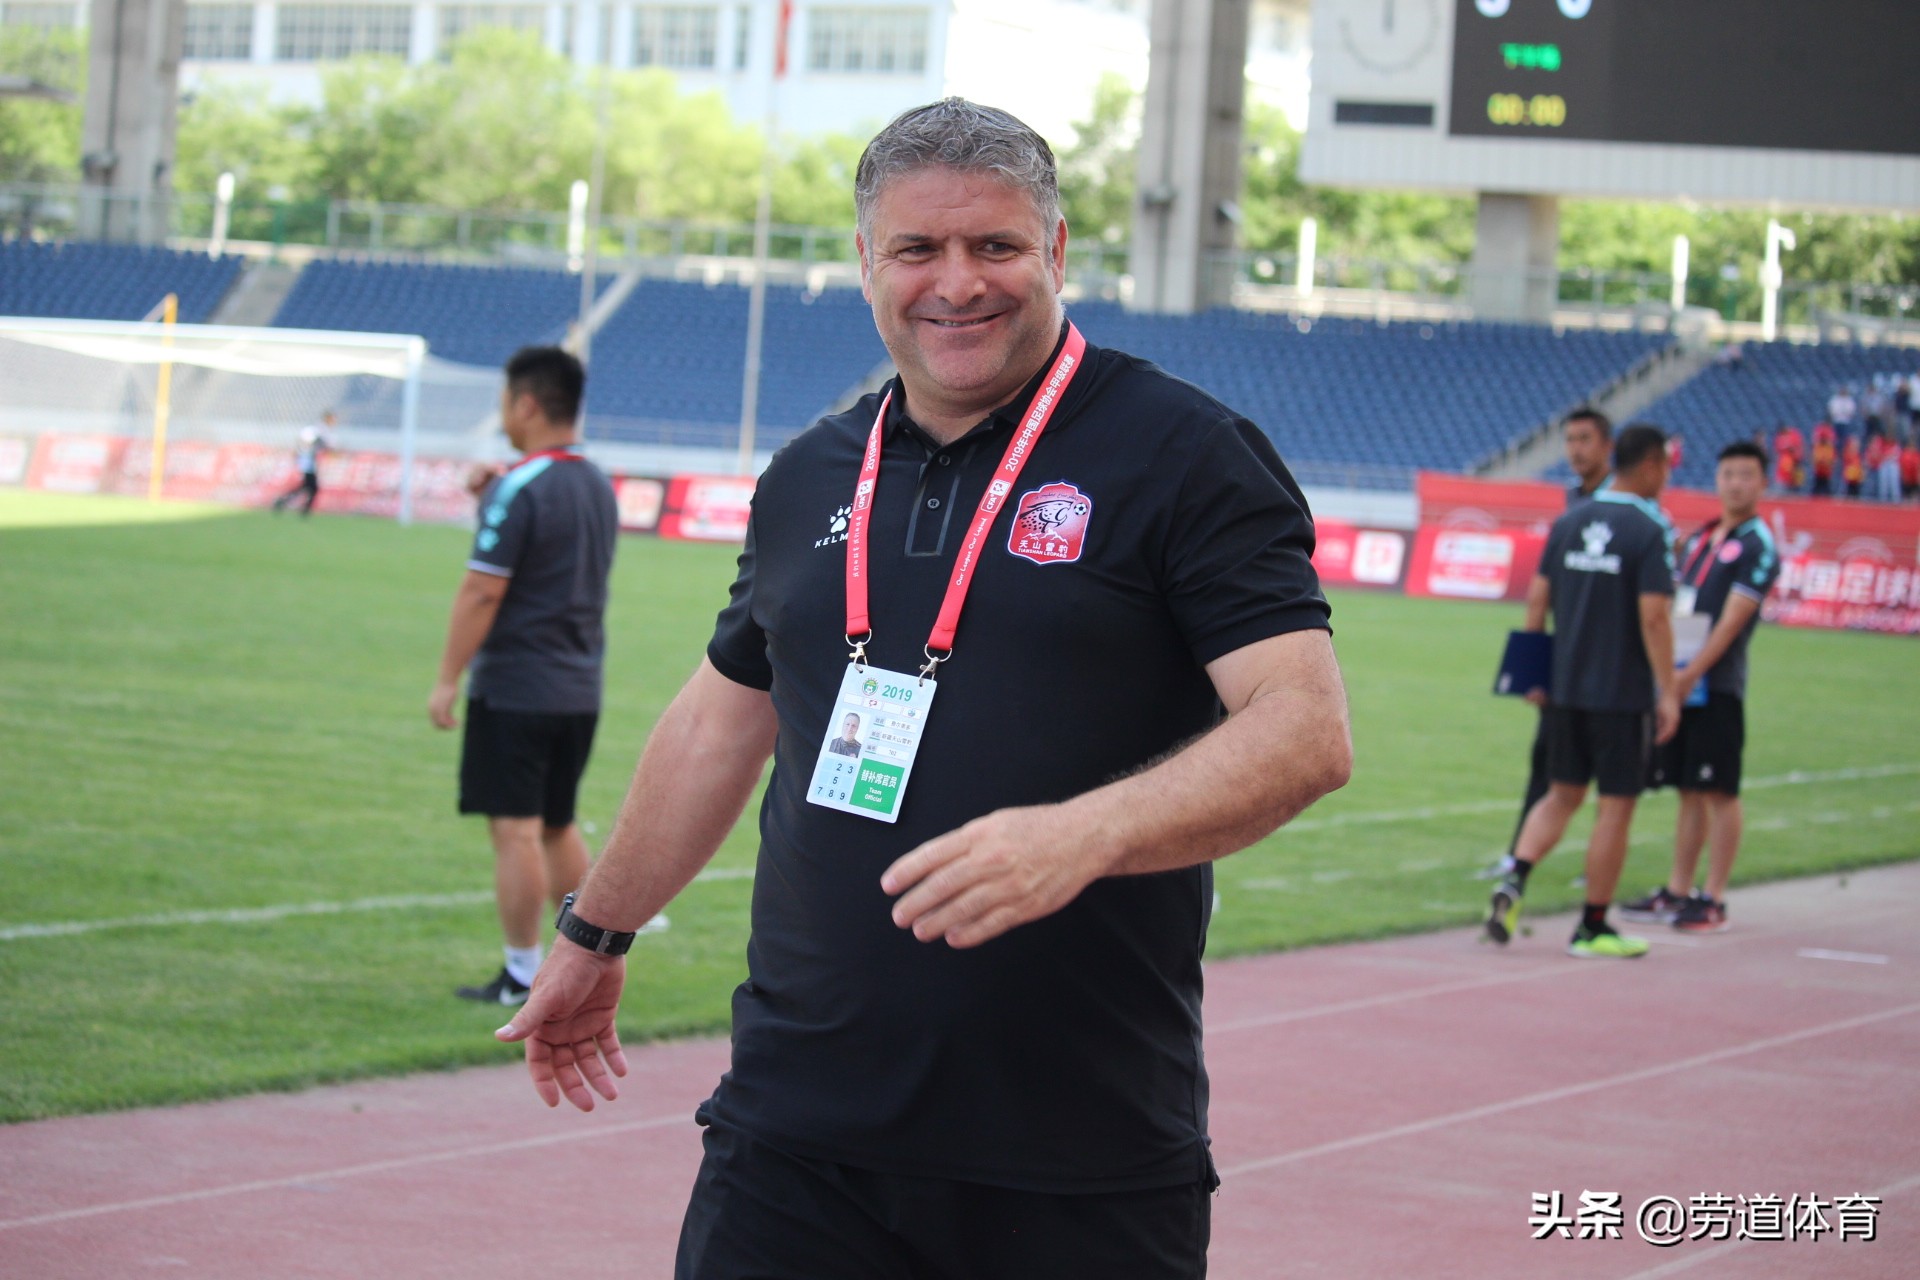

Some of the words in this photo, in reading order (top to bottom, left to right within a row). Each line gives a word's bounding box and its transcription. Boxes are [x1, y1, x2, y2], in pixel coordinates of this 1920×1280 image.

[1005, 354, 1075, 472] 2019年中国足球协会甲级联赛
[987, 495, 998, 510] CFA
[815, 532, 849, 549] KELM
[956, 574, 964, 586] Our
[960, 551, 972, 572] League
[968, 537, 977, 549] Our
[974, 518, 988, 536] Legend
[882, 684, 913, 702] 2019
[861, 769, 898, 788] 替补席官员
[864, 793, 883, 803] Official
[869, 787, 882, 795] Team
